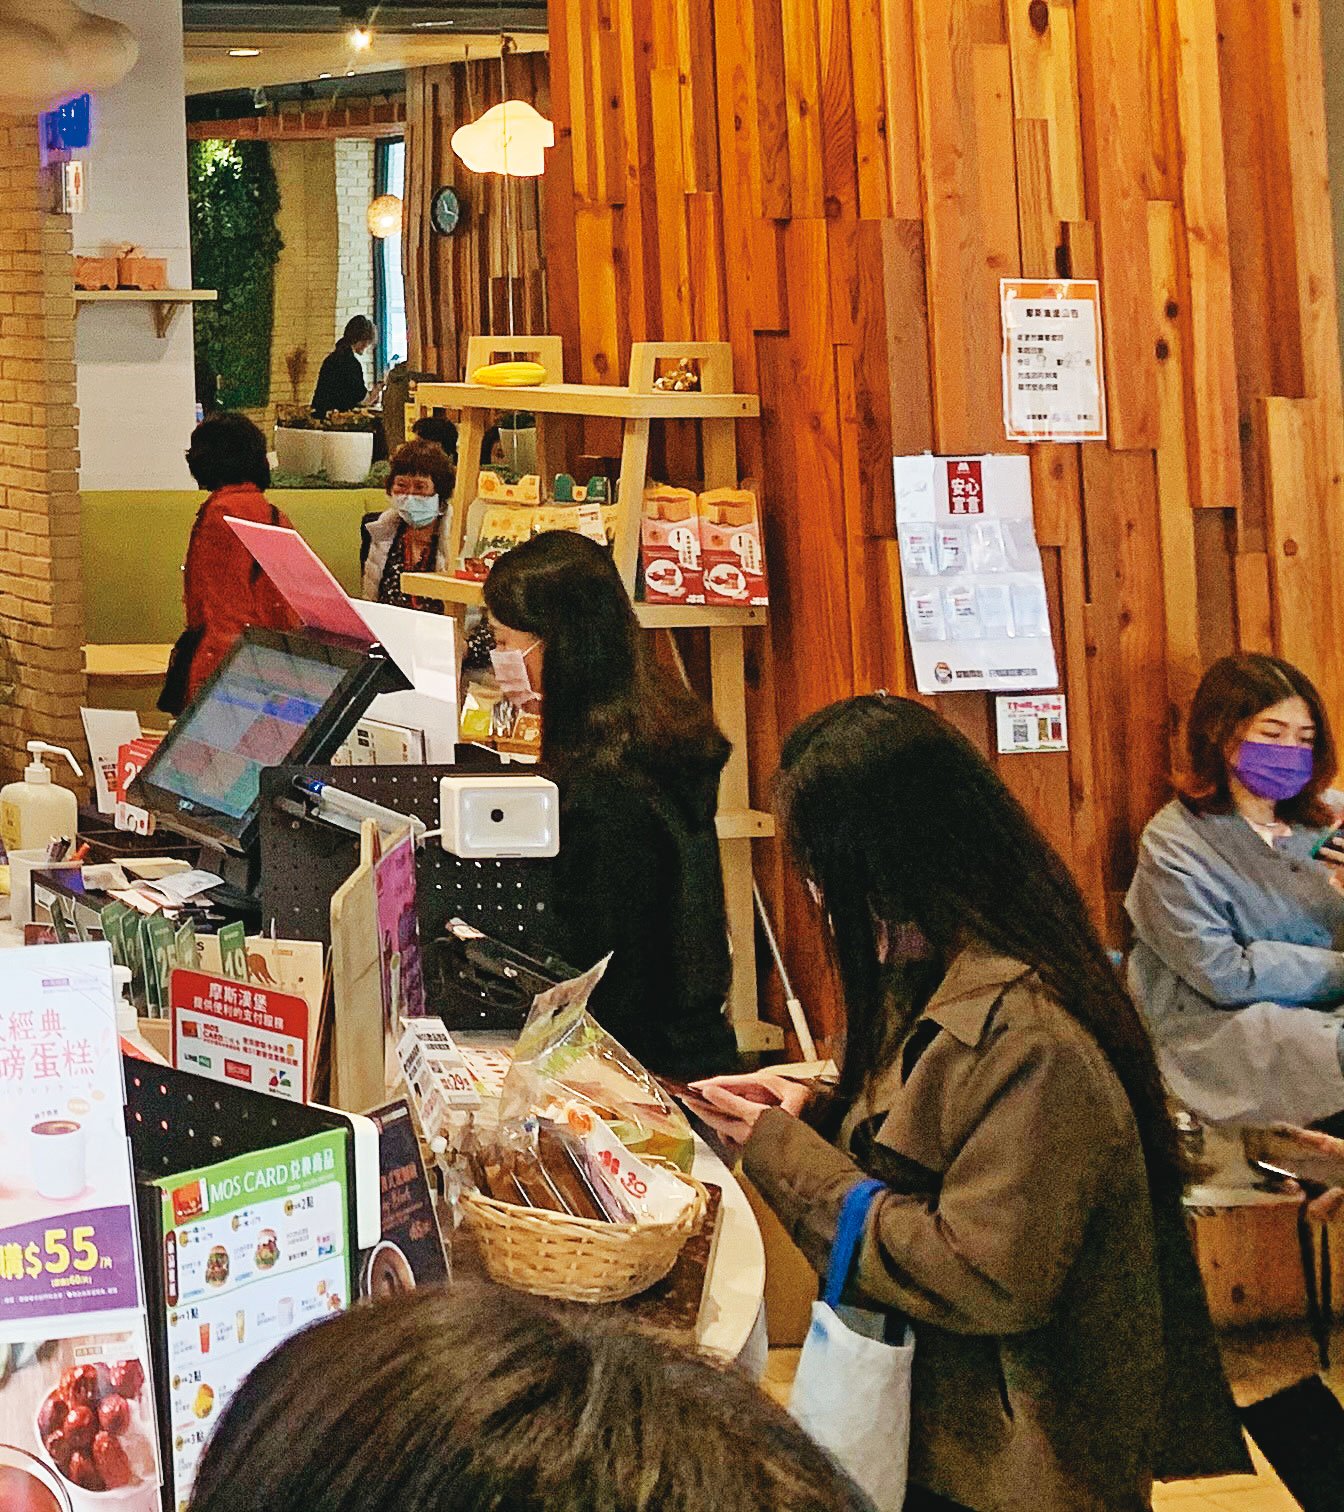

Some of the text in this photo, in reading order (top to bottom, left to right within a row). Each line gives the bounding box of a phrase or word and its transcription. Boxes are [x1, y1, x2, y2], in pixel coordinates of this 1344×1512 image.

[950, 477, 980, 496] 安心
[208, 982, 268, 1014] 摩斯漢堡
[210, 1174, 242, 1205] MOS
[243, 1164, 289, 1194] CARD
